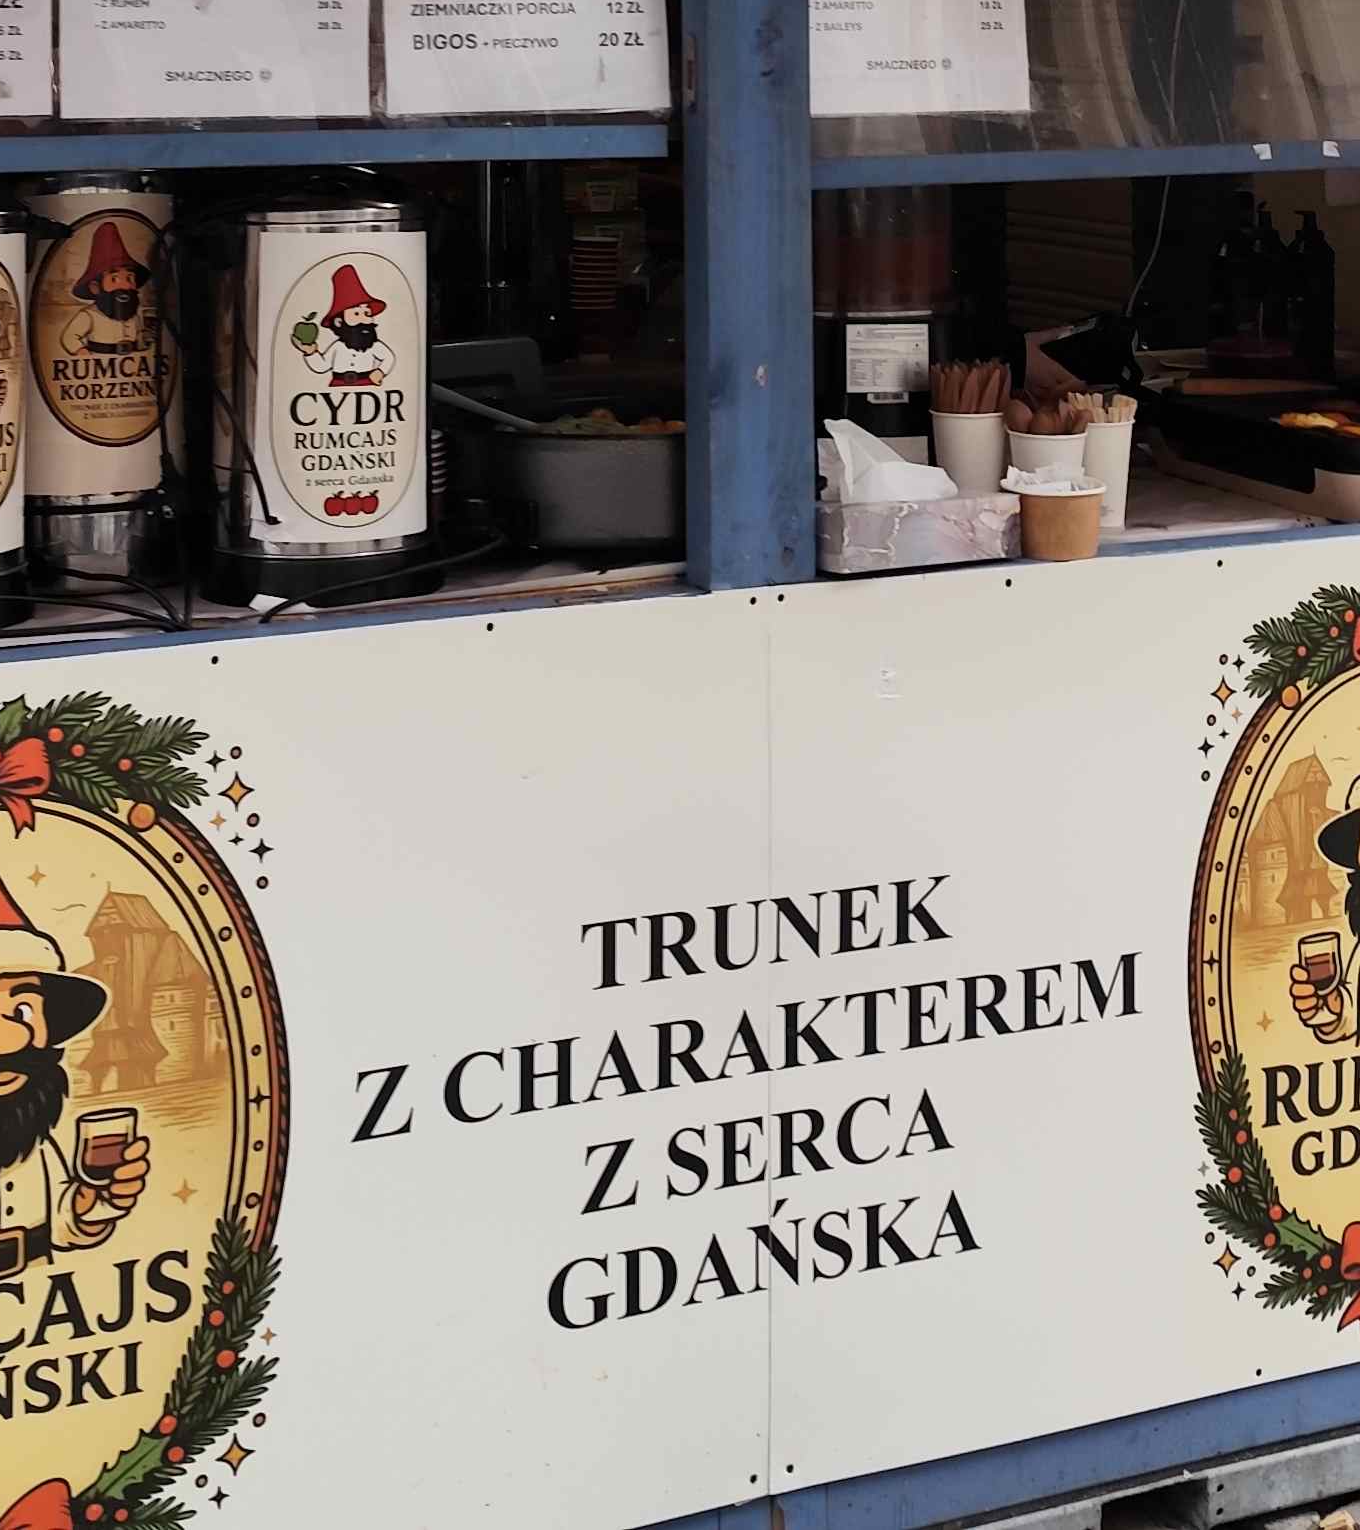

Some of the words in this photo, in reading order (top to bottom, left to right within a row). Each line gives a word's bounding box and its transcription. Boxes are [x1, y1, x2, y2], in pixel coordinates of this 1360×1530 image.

[410, 2, 513, 17] ZIEMNIACZKI
[517, 1, 576, 15] PORCJA
[607, 1, 624, 14] 12
[626, 1, 645, 14] ZŁ
[822, 2, 874, 10] AMARETTO
[823, 23, 862, 31] BAILEYS
[413, 33, 479, 50] BIGOS
[492, 37, 559, 49] PIECZYWO
[599, 32, 620, 47] 20
[624, 32, 645, 47] ZŁ
[866, 60, 936, 70] SMACZNEGO
[165, 70, 253, 82] SMACZNEGO
[60, 380, 157, 400] KORZENN
[290, 389, 406, 426] CYDR
[294, 429, 398, 450] RUMCAJS
[301, 450, 396, 471] GDAŃSKI
[580, 875, 954, 990] TRUNEK
[351, 1063, 415, 1143] Z
[443, 951, 1143, 1123] CHARAKTEREM
[580, 1137, 639, 1215] Z
[667, 1088, 954, 1200] SERCA
[547, 1189, 982, 1330] GDAŃSKA
